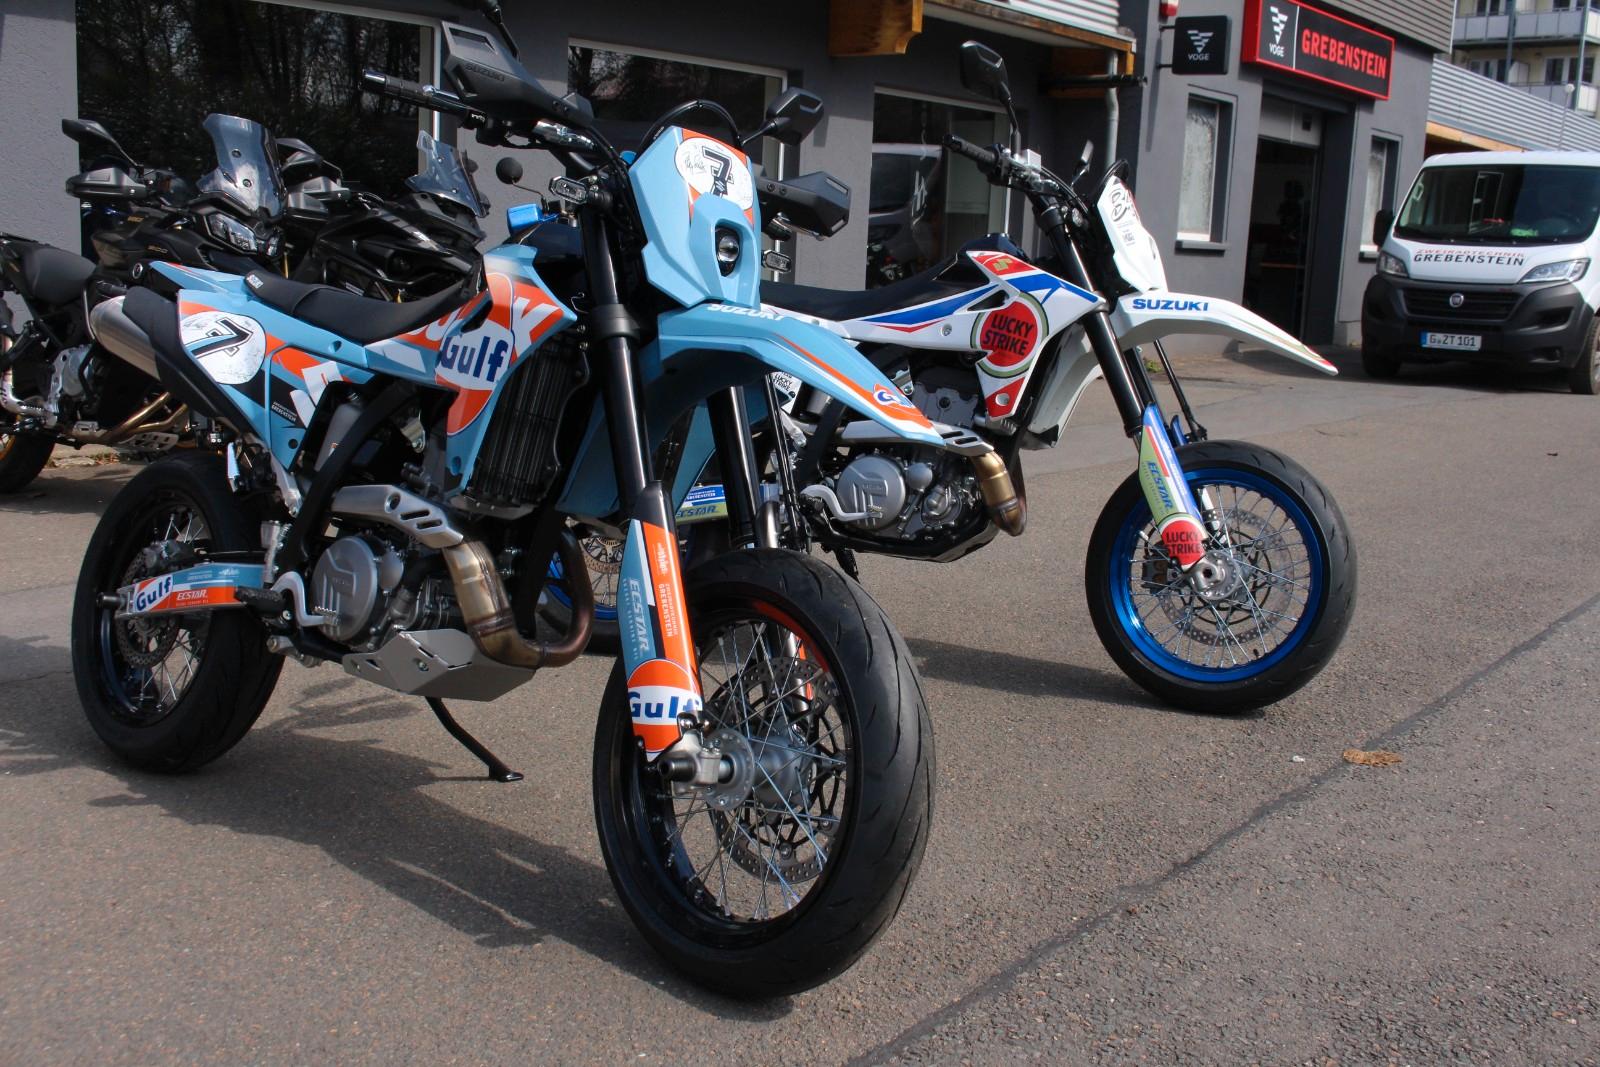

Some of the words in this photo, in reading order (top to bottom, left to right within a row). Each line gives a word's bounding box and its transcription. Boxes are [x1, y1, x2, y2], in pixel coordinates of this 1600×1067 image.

[1188, 53, 1210, 61] VOGE
[1269, 43, 1285, 57] VOGE
[1302, 28, 1387, 79] GREBENSTEIN
[1414, 254, 1525, 266] GREBENSTEIN
[707, 303, 784, 321] SUZUKI
[1132, 298, 1209, 312] SUZUKI
[990, 313, 1034, 336] LUCKY
[983, 329, 1029, 356] STRIKE
[1429, 334, 1437, 344] G
[1442, 335, 1456, 345] ZT
[440, 335, 509, 383] Gulf
[774, 374, 793, 387] LUCKY
[1166, 531, 1199, 543] LUCKY
[136, 576, 172, 611] Gulf
[176, 589, 208, 600] ECSTAR
[629, 578, 649, 652] ECSTAR
[658, 583, 673, 638] GREBENSTEIN
[628, 691, 703, 719] Gulf
